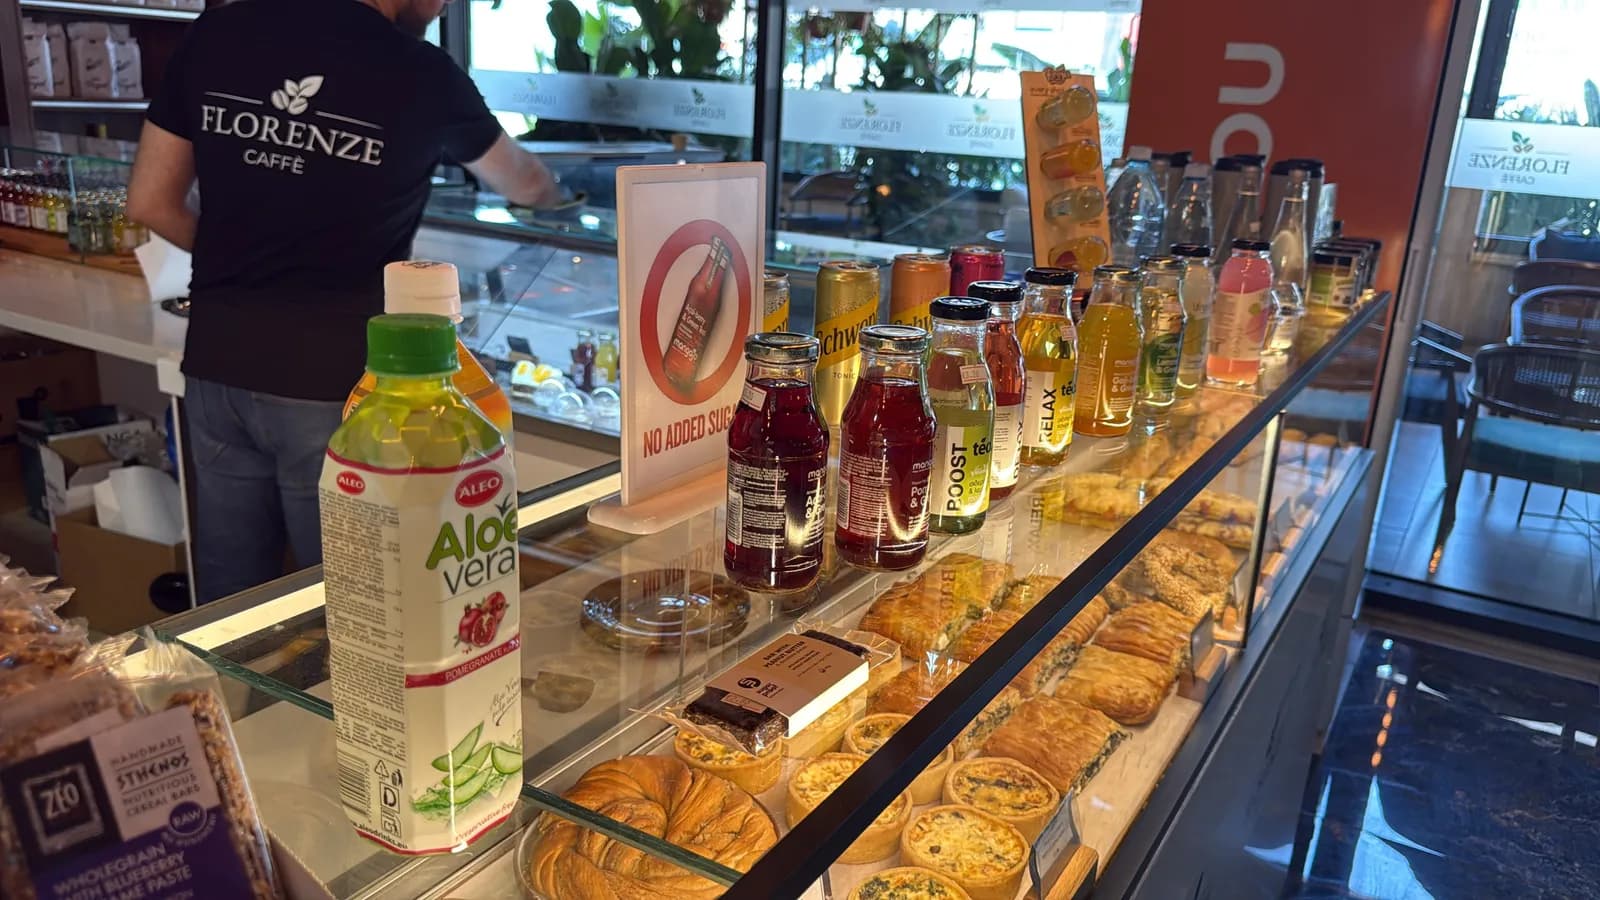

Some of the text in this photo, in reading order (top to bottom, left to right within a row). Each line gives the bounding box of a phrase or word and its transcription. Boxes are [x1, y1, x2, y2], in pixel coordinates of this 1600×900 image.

[201, 104, 385, 167] FLORENZE
[243, 149, 305, 175] CAFFÈ
[833, 371, 856, 380] TONIC
[643, 403, 737, 459] NO ADDED SUGA
[1039, 388, 1057, 443] RELAX
[338, 475, 365, 490] ALEO
[457, 475, 500, 500] ALEO
[425, 506, 518, 570] Aloe
[443, 545, 516, 595] vera
[445, 647, 503, 681] POMEGRANATE
[110, 735, 183, 766] HANDMADE
[122, 773, 198, 806] NUTRITIOUS
[126, 784, 201, 818] CEREAL BARS
[53, 842, 166, 895] WHOLEGRAIN
[103, 851, 185, 893] BLUEBERRY
